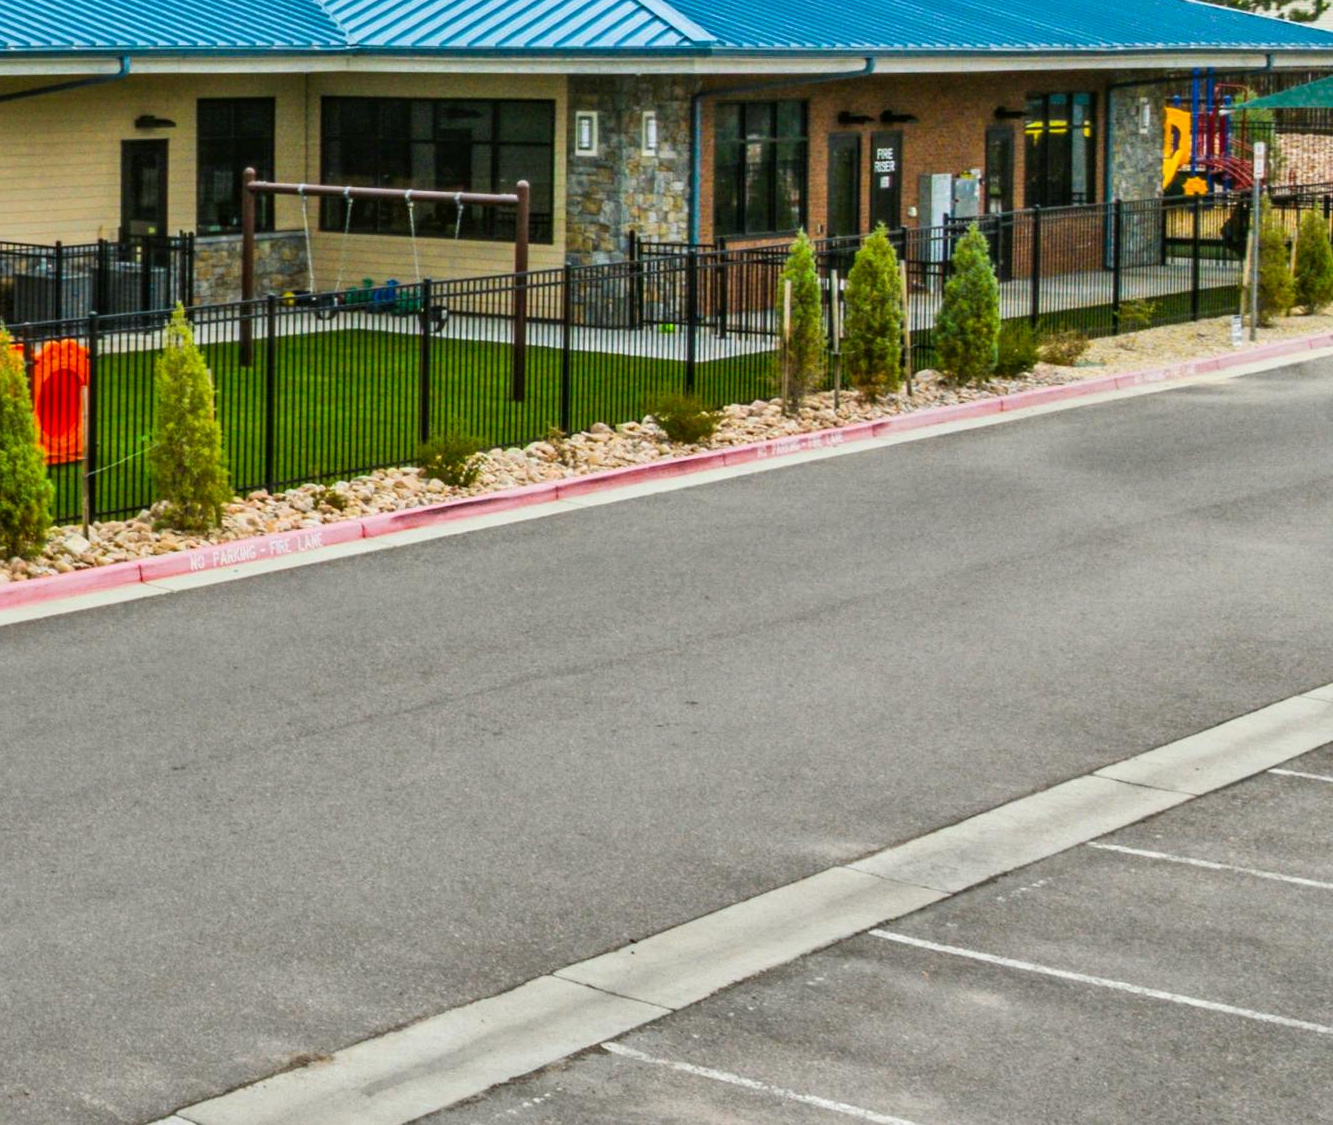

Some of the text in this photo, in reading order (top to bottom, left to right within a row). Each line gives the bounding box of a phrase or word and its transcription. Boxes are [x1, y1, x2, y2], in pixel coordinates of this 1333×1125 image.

[189, 555, 205, 571] NO
[212, 544, 256, 566] PARKING
[269, 538, 292, 556] FIRE
[296, 531, 324, 552] LANE
